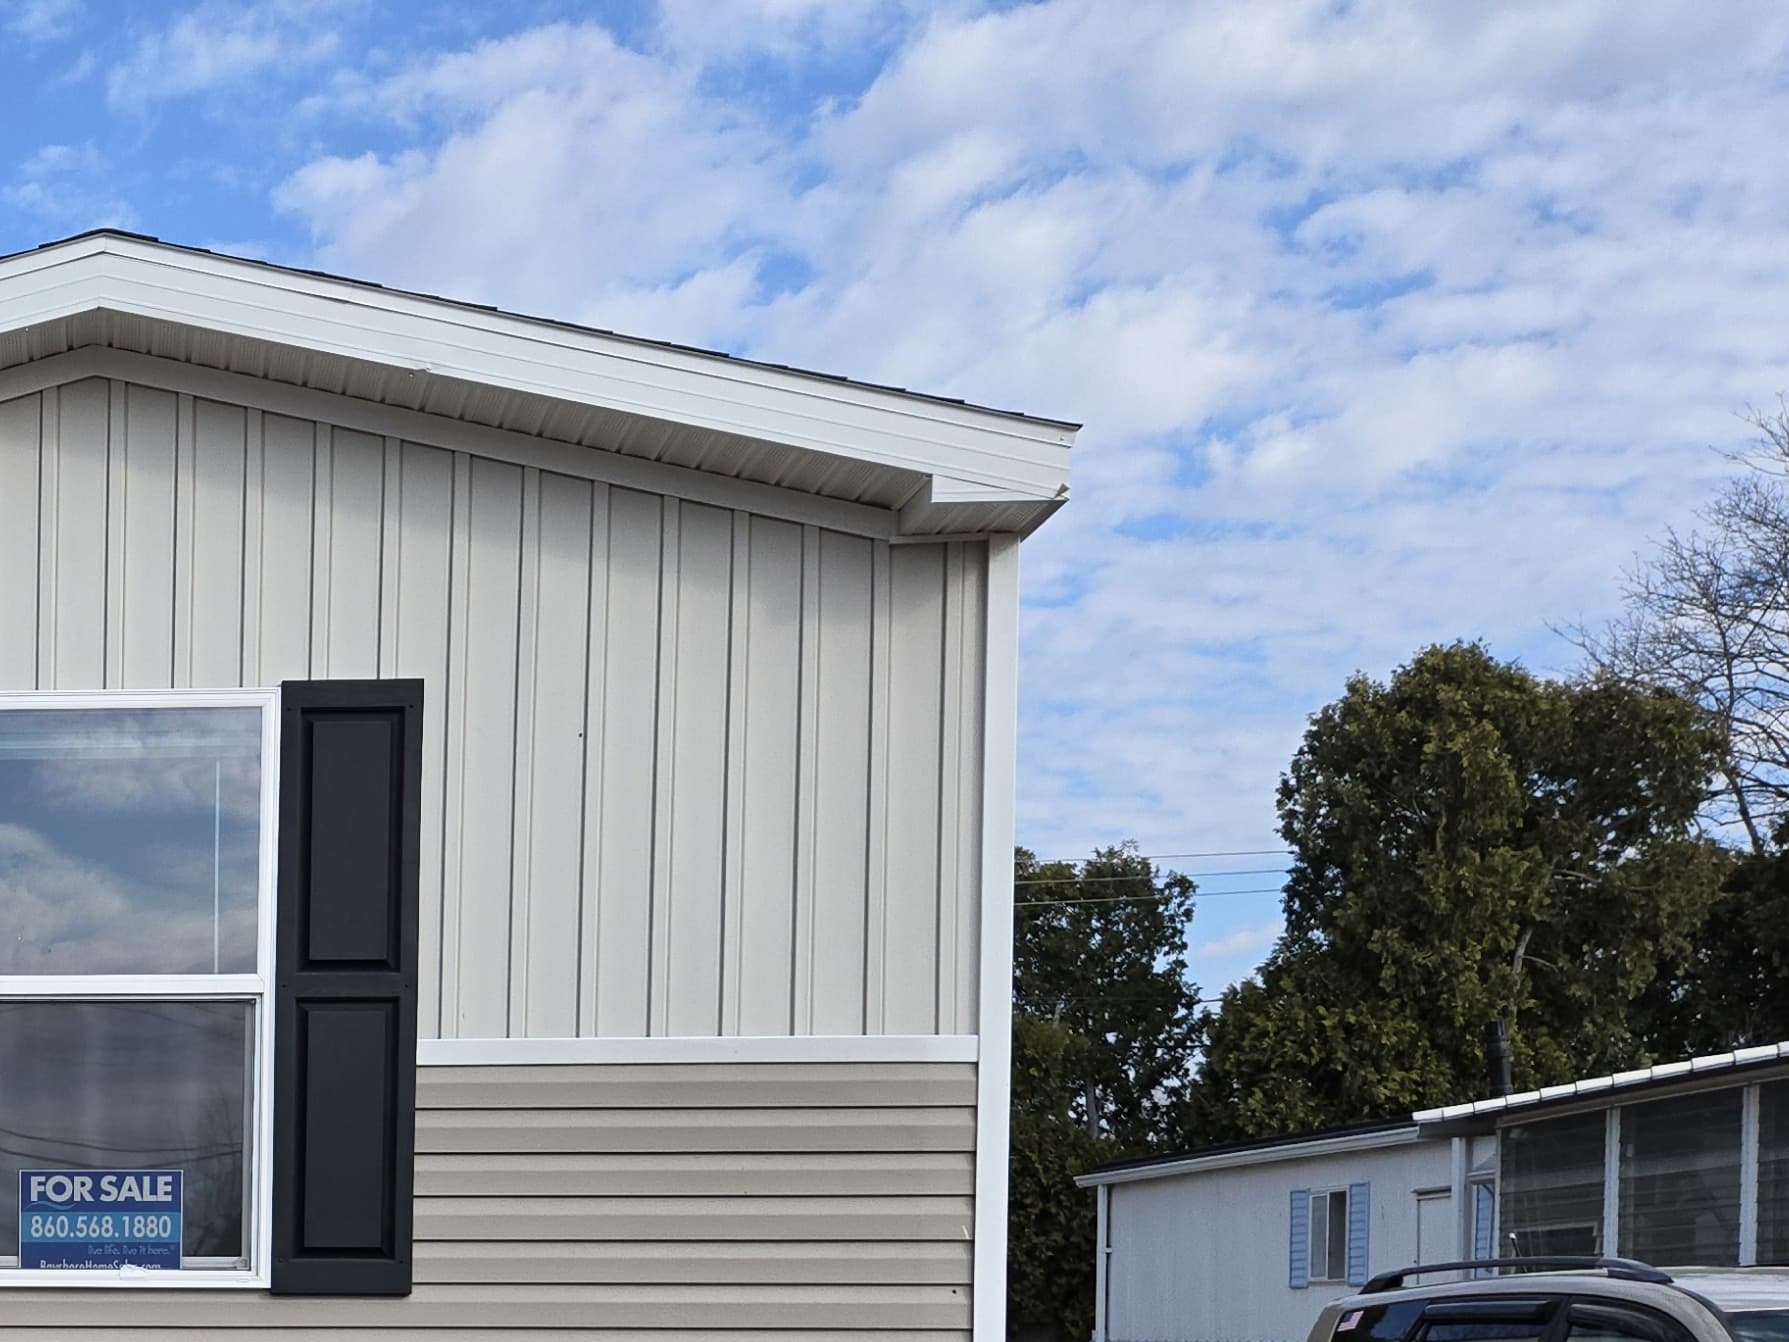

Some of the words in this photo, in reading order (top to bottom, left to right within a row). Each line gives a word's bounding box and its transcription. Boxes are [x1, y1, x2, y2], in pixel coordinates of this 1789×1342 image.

[30, 1175, 92, 1202] FOR
[99, 1175, 173, 1202] SALE
[30, 1215, 171, 1239] 860.568.1880
